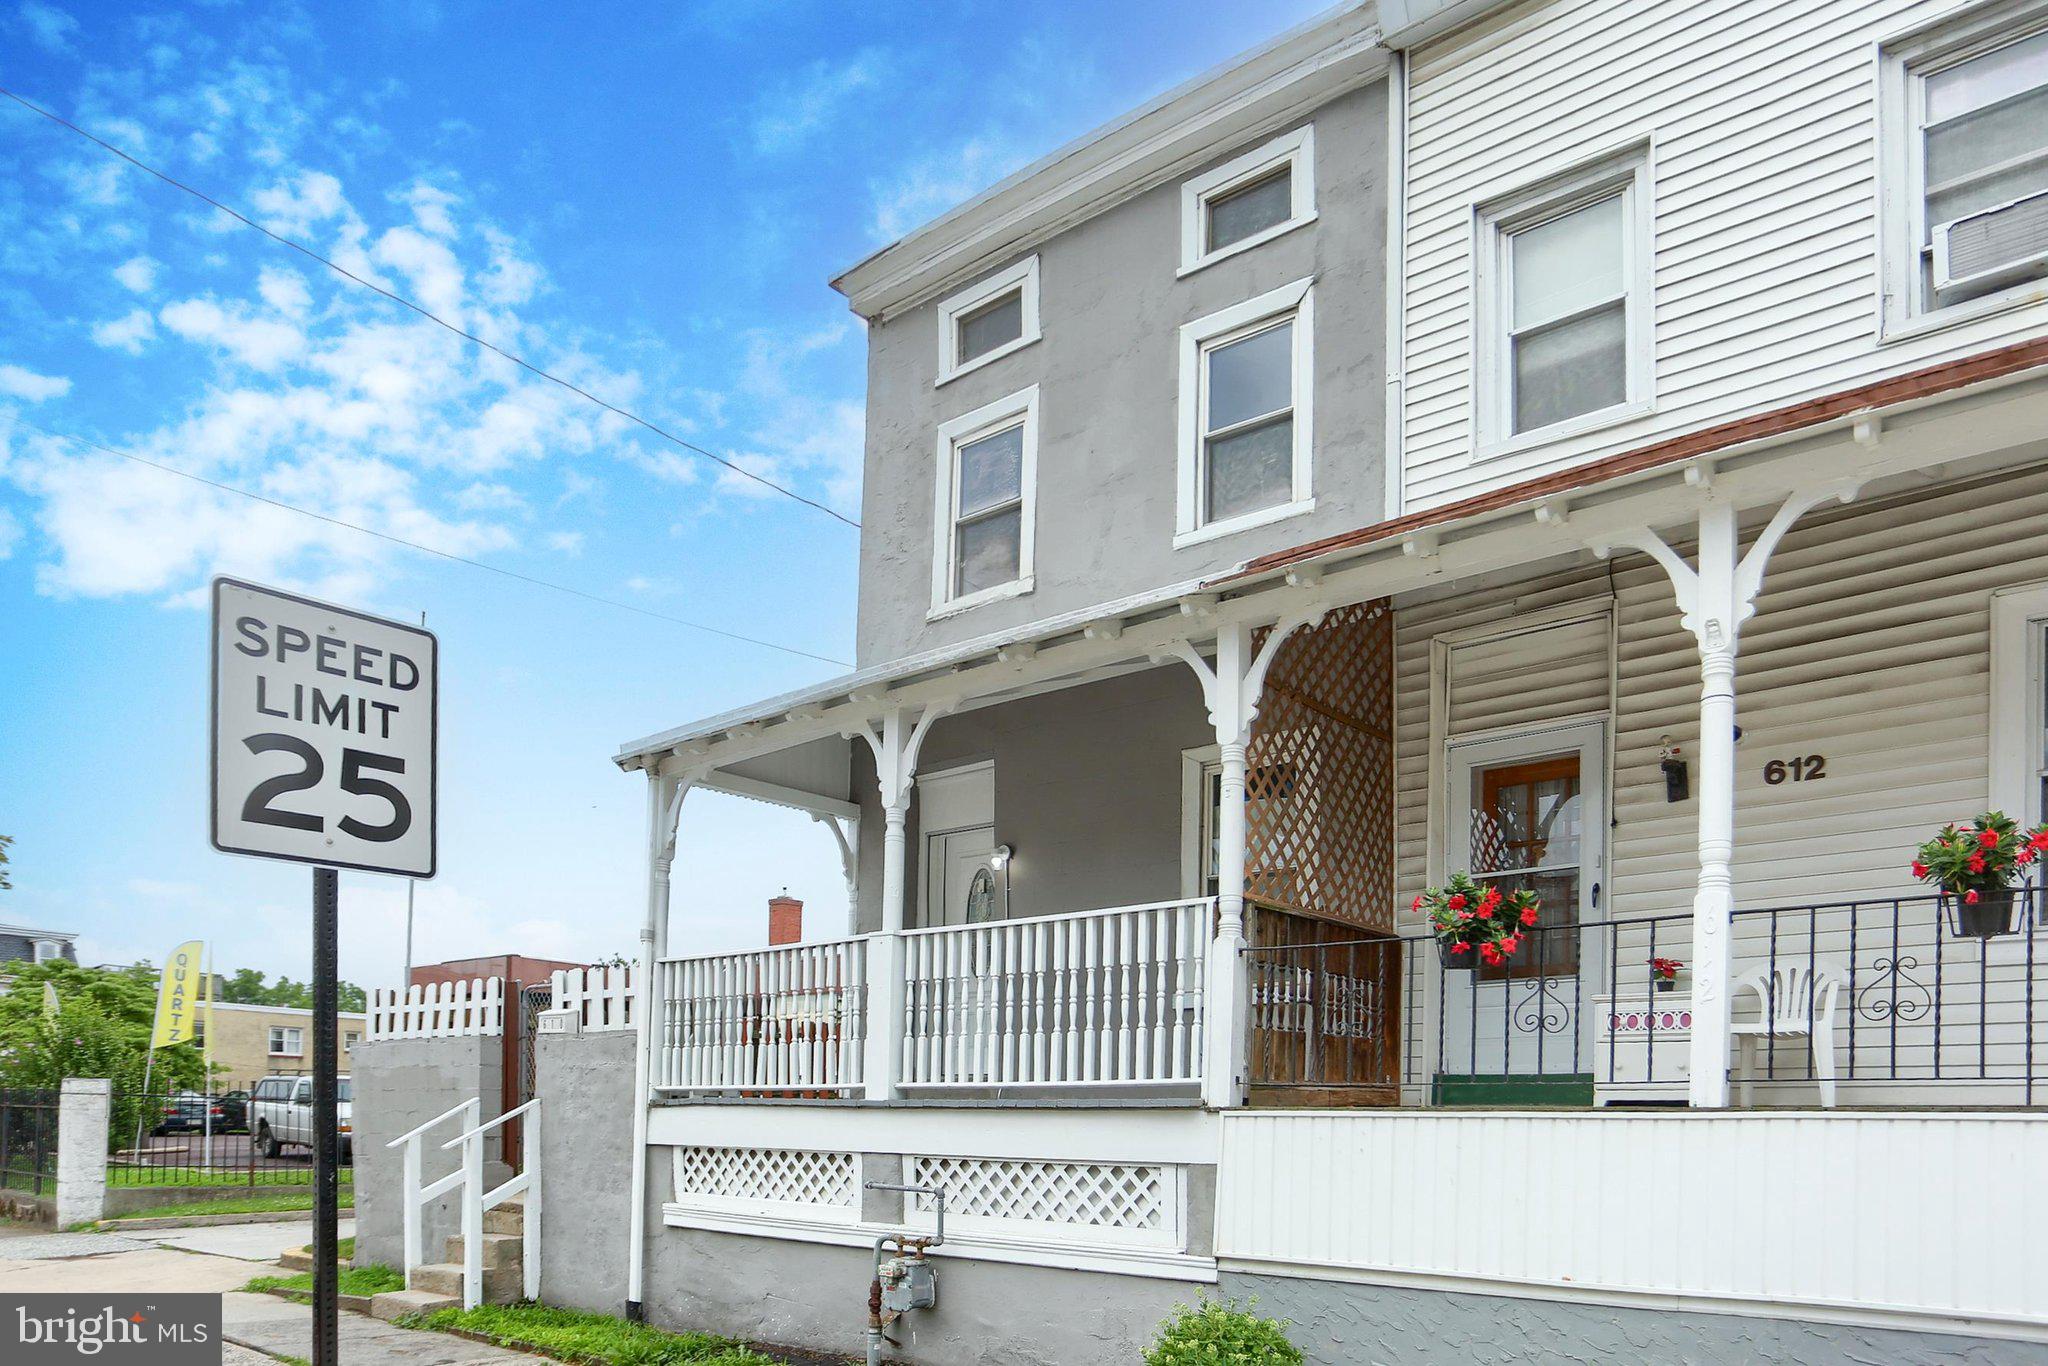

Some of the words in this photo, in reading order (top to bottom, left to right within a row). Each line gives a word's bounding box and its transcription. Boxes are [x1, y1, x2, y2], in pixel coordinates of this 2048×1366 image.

[234, 616, 420, 691] SPEED
[256, 675, 400, 739] LIMIT
[241, 732, 412, 843] 25
[1763, 754, 1827, 785] 612
[168, 953, 188, 1041] QUARTZ
